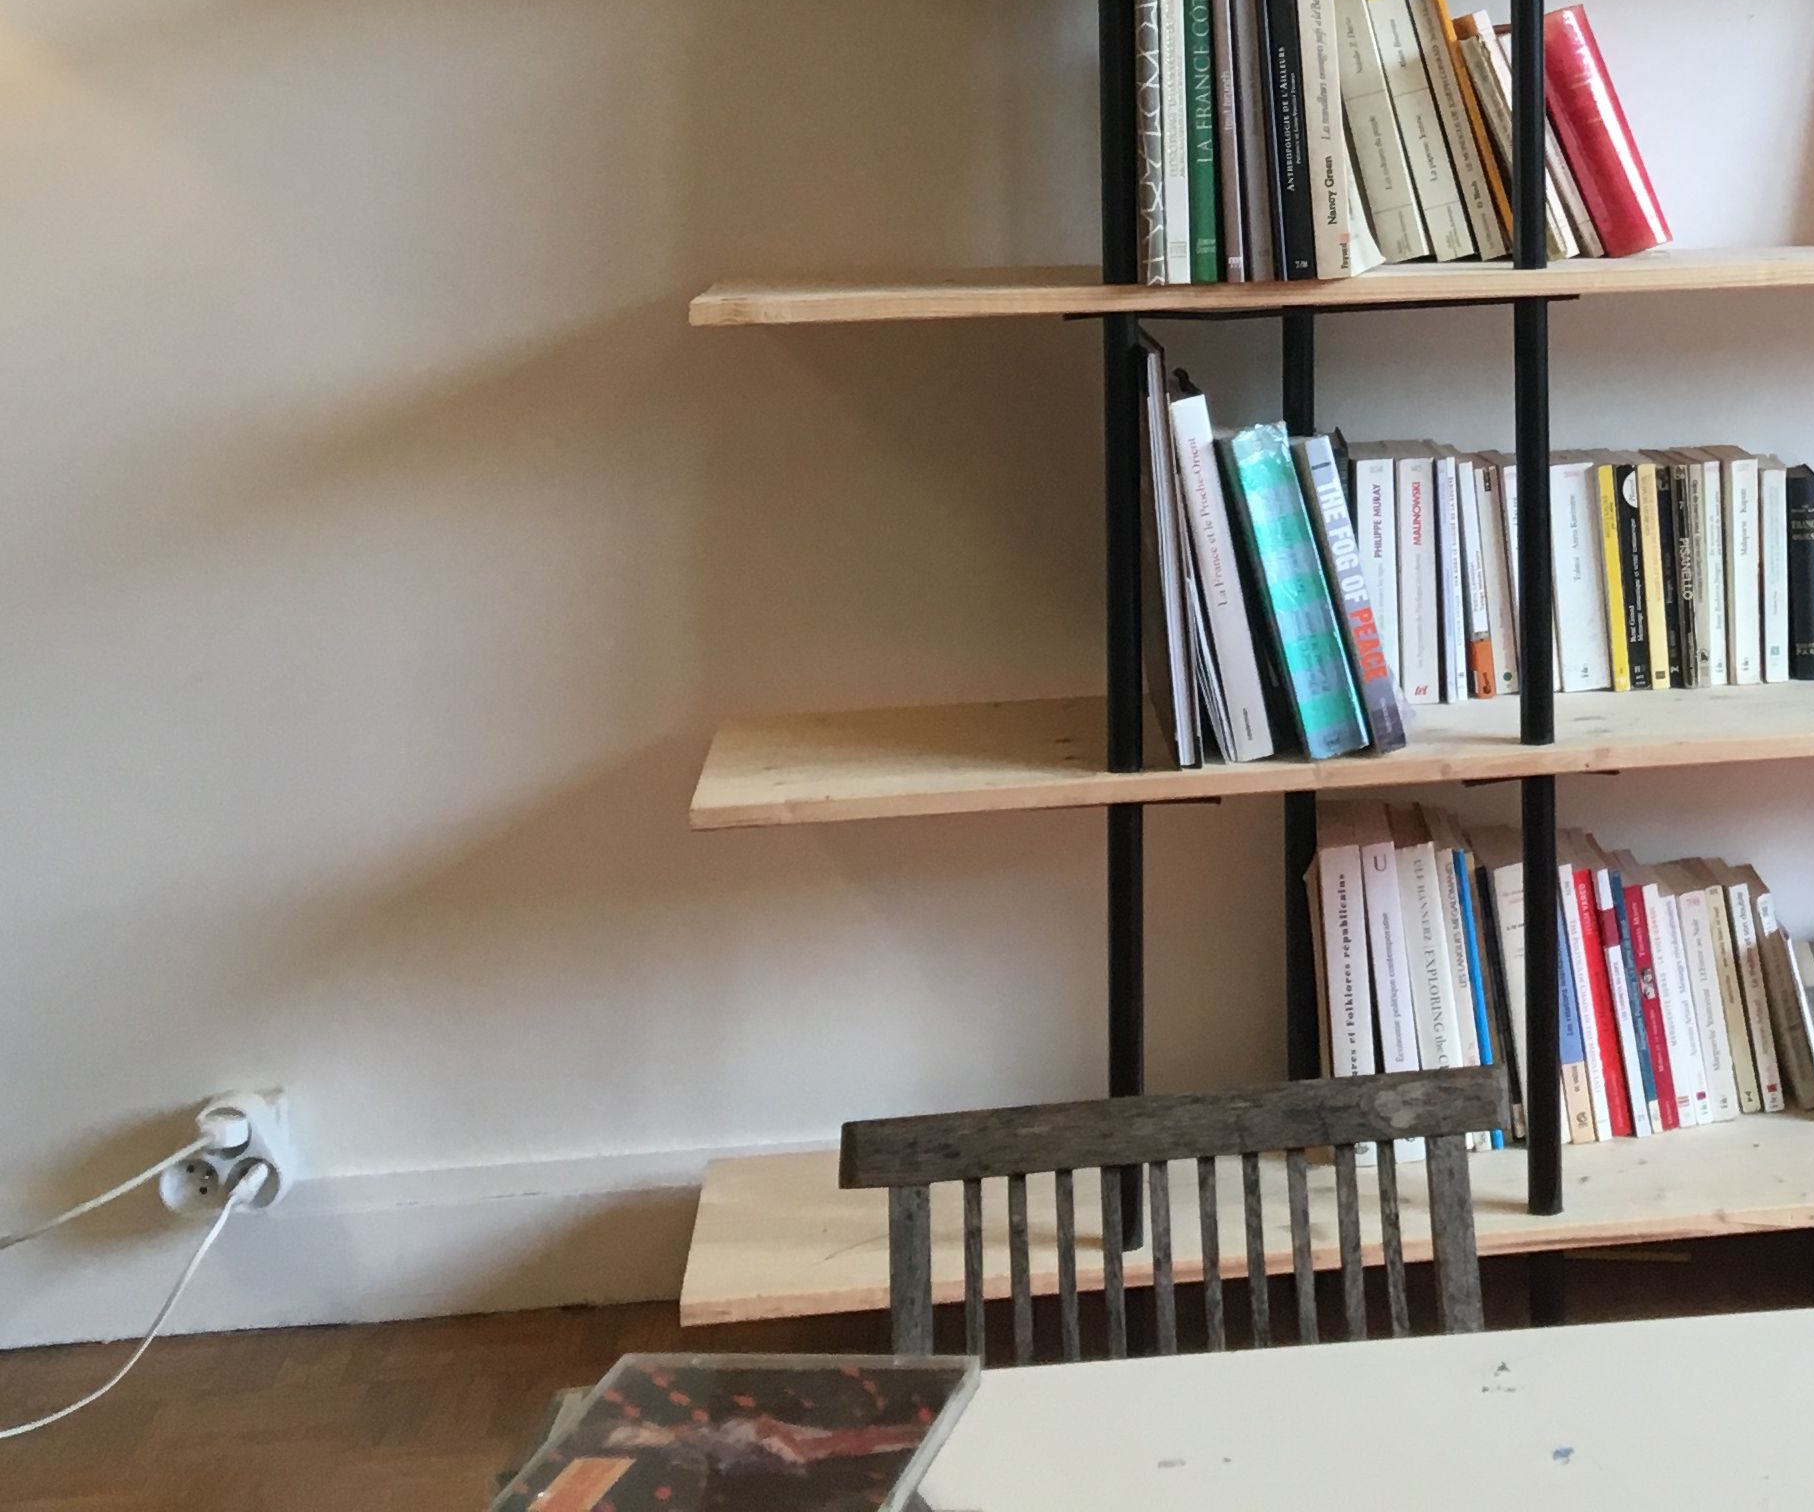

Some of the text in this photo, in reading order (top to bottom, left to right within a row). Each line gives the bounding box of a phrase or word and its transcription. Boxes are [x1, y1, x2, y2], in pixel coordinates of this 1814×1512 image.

[1194, 45, 1214, 133] FRANCE
[1280, 100, 1288, 111] DE
[1198, 139, 1214, 163] LA
[1322, 155, 1340, 225] Nancy Green
[1184, 433, 1229, 607] La France et le Proche-Orient
[1371, 482, 1383, 558] PHILIPPE MURAY
[1411, 481, 1422, 545] MALINOWSKI
[1738, 488, 1749, 555] Malaparte Kaputt
[1318, 476, 1387, 686] THE FOG OF PEACE
[1679, 536, 1693, 600] PISANELLO
[1335, 872, 1356, 1043] et Folklores républicains
[1740, 920, 1750, 935] son
[1387, 978, 1401, 1018] politique
[1423, 948, 1444, 1032] EXPLORING
[1435, 1034, 1447, 1053] the
